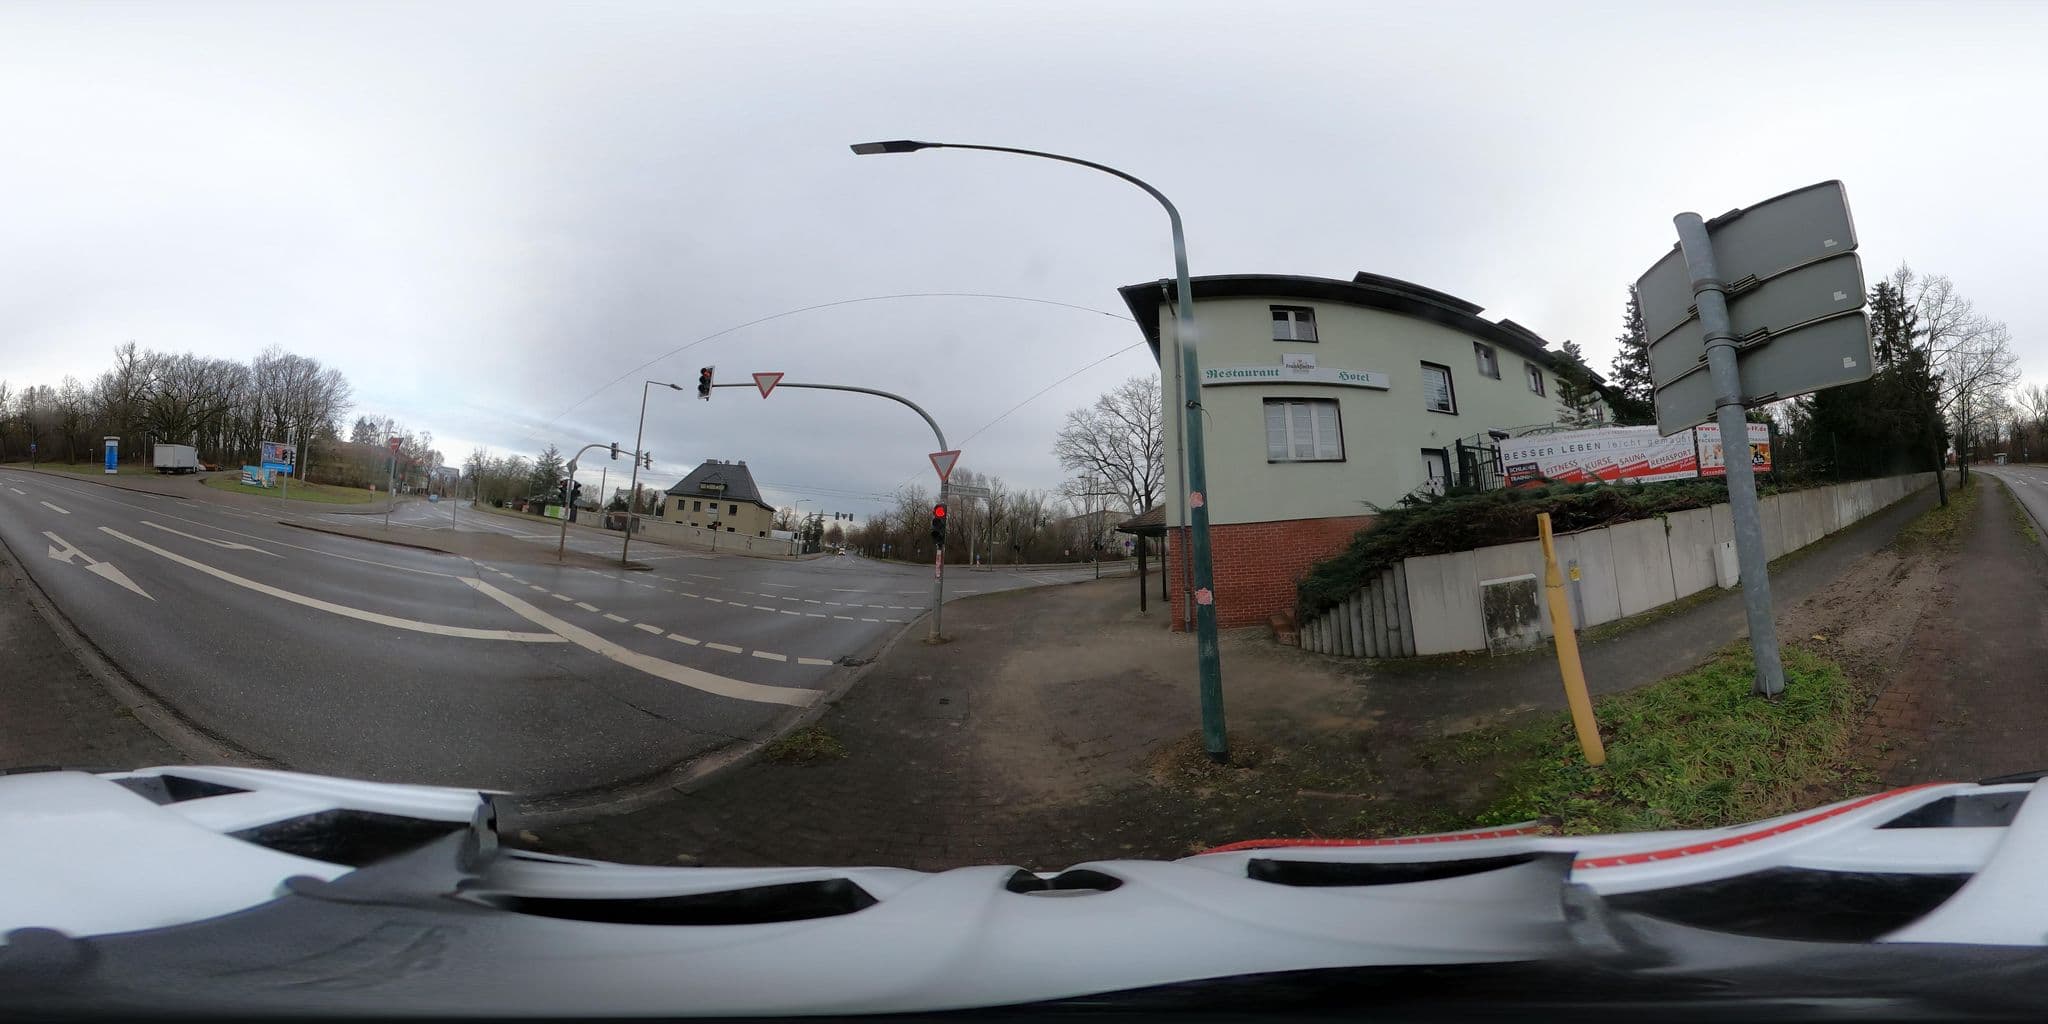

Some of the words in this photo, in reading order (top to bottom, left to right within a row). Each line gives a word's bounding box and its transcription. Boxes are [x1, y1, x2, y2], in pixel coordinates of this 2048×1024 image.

[1206, 368, 1280, 378] Restaurant
[1339, 371, 1370, 382] Hotel
[1504, 448, 1554, 460] BESSER
[1561, 442, 1601, 454] LEBEN
[1607, 438, 1642, 449] leicht
[1584, 456, 1613, 472] KURSE
[1619, 452, 1646, 466] SAUNA
[1650, 448, 1692, 467] REHASPORT
[1545, 458, 1578, 475] FITNESS
